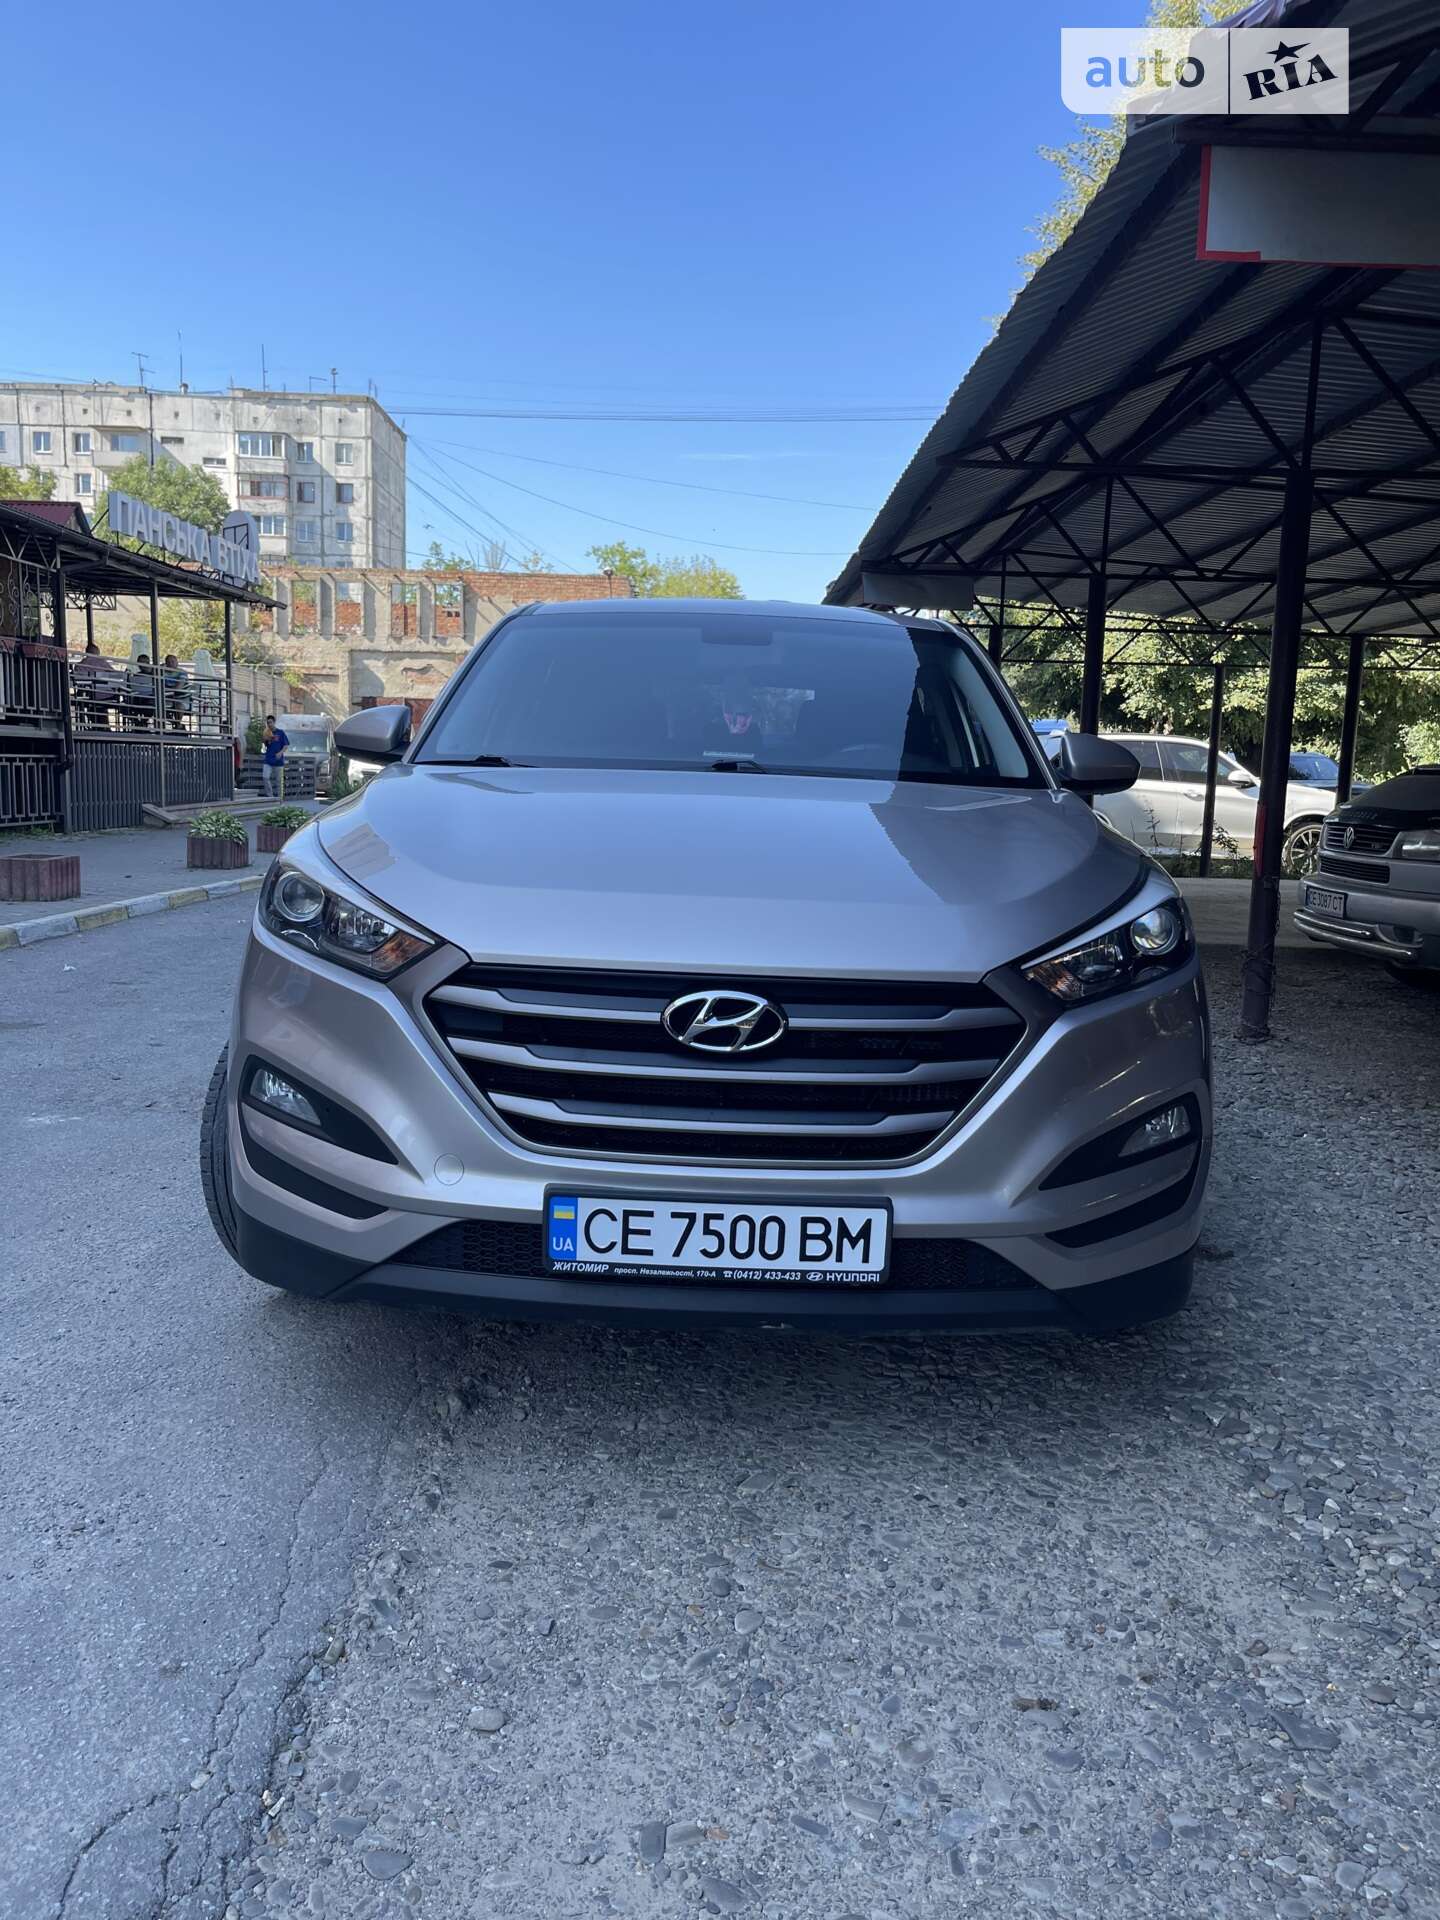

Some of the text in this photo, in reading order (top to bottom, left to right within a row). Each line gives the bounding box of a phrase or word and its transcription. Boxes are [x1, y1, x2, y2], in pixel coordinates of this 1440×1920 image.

[109, 490, 212, 566] ПАНСЬКА
[552, 1237, 574, 1252] UA
[584, 1208, 873, 1264] CE 7500 BM
[552, 1261, 609, 1273] ЖИТОМИР
[733, 1270, 763, 1280] (0412)
[764, 1270, 801, 1281] 433-433
[826, 1272, 880, 1282] HYUNDAI
